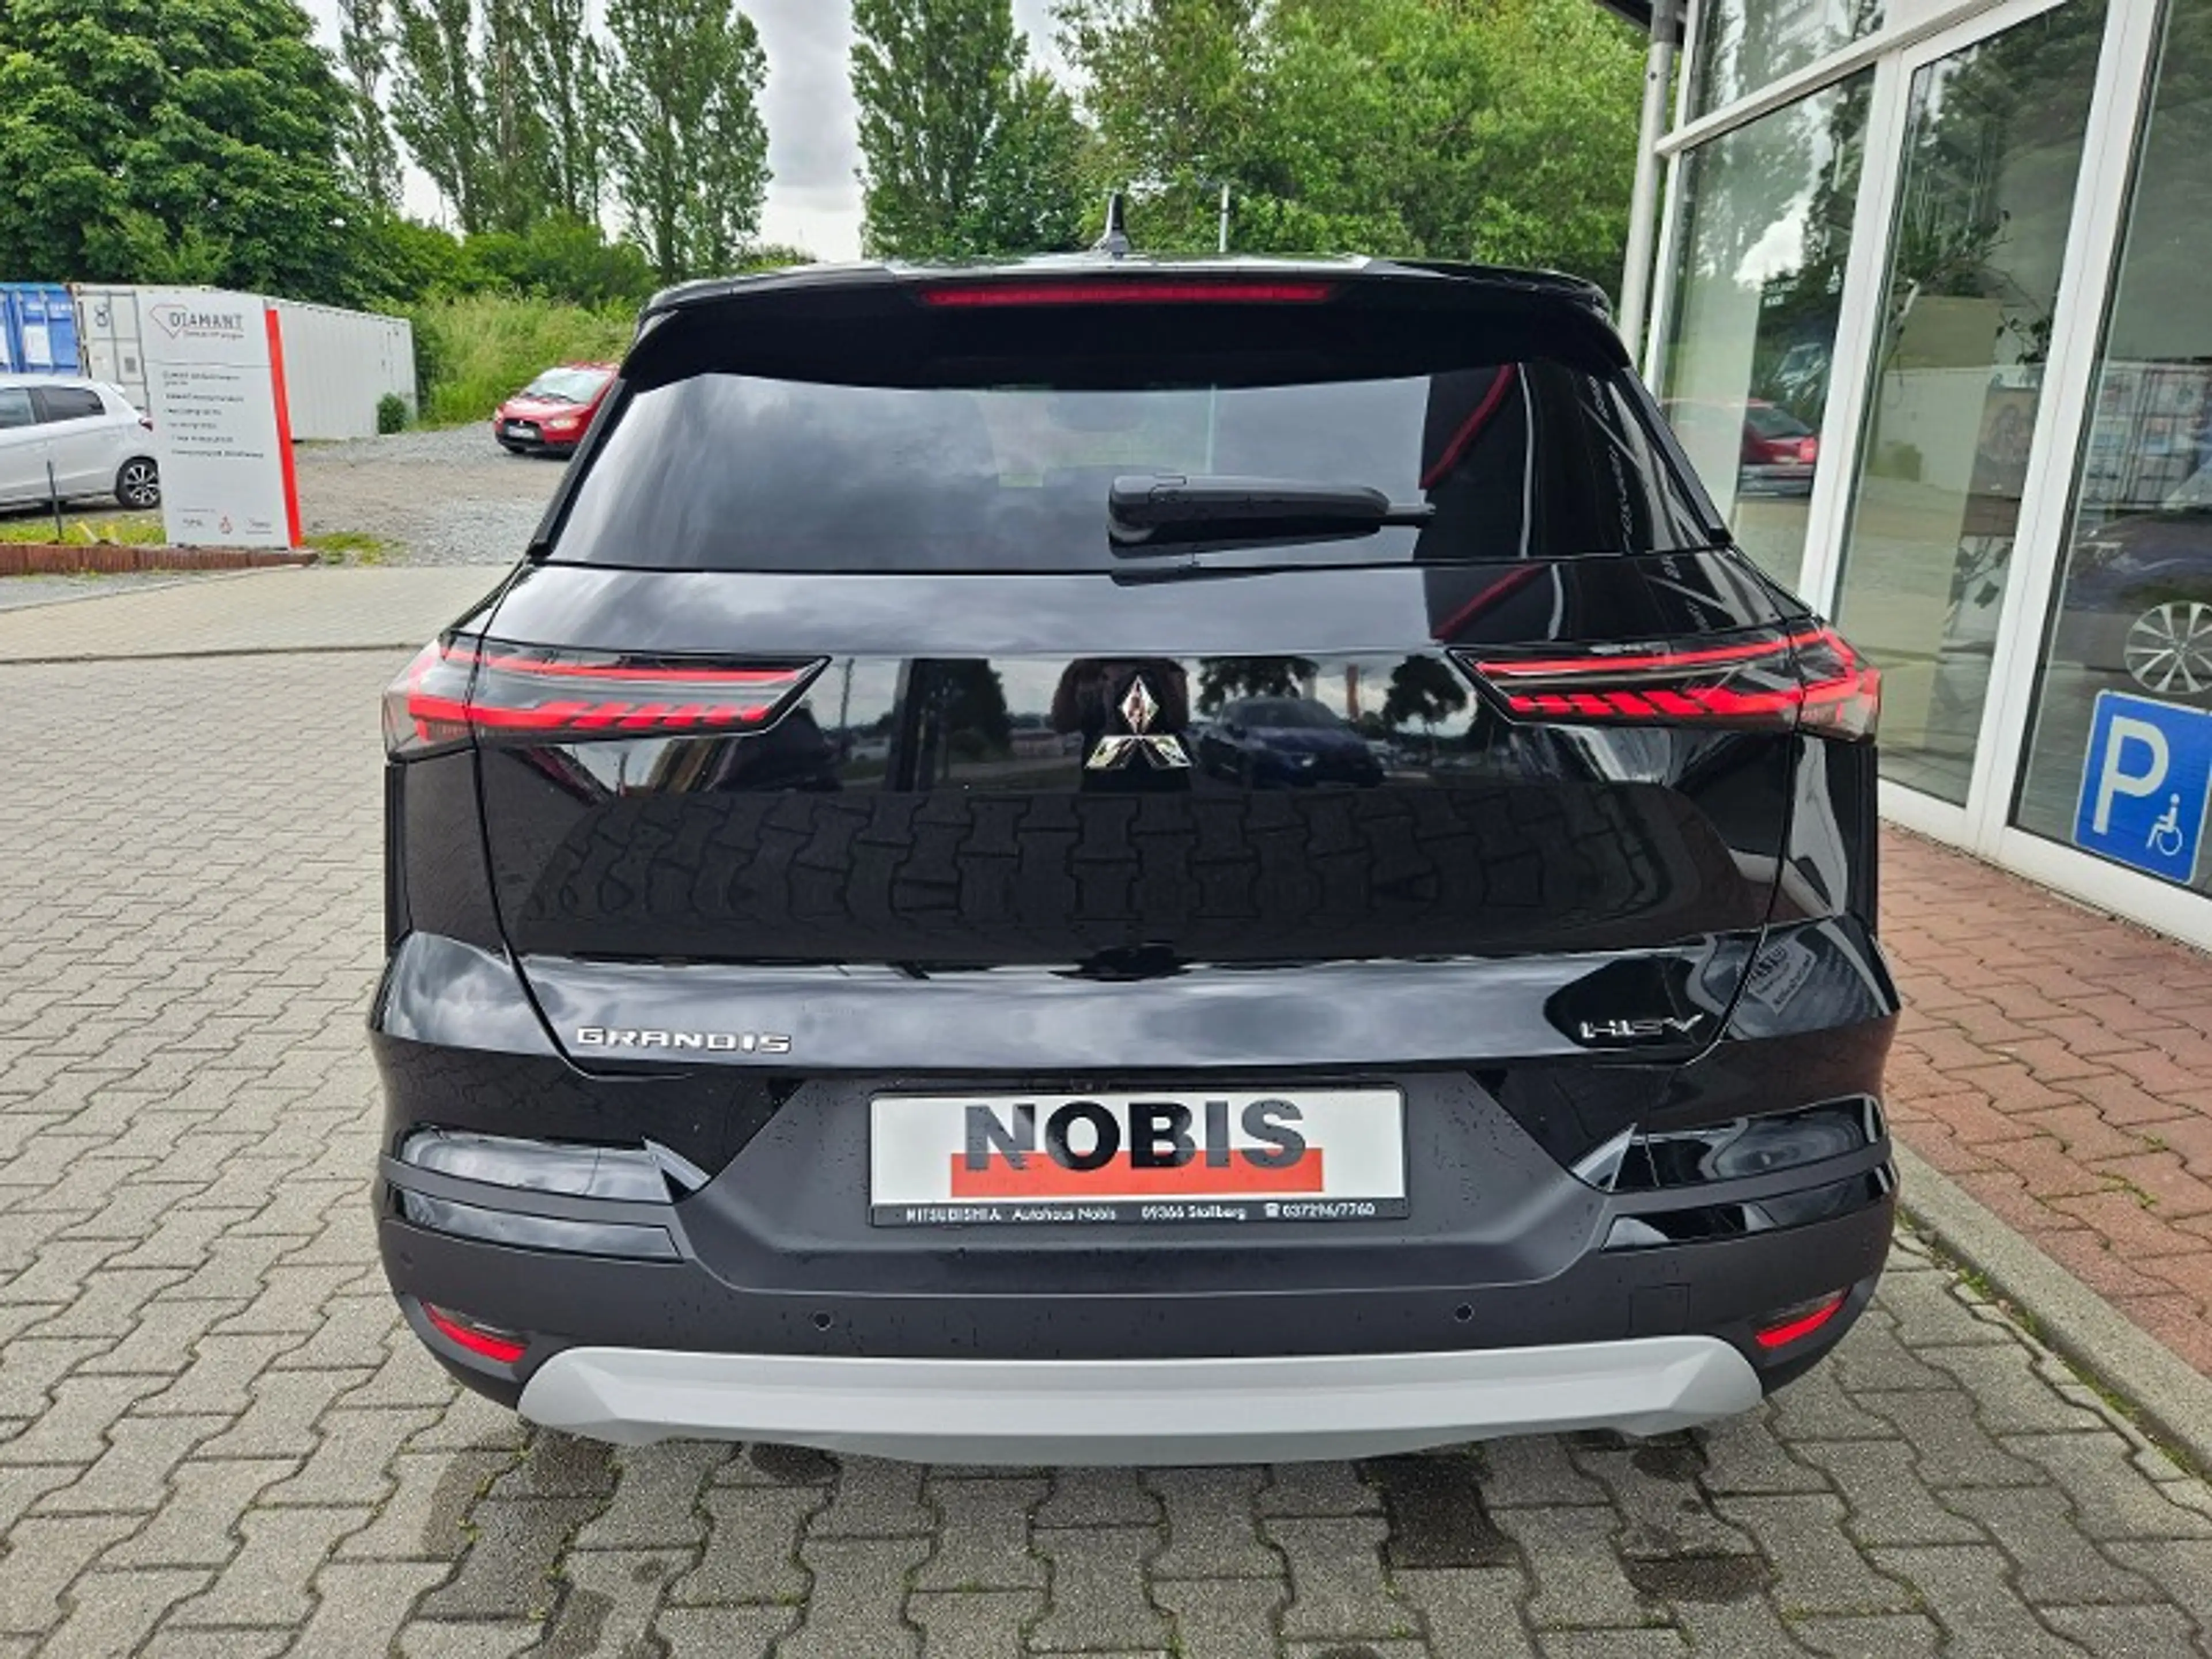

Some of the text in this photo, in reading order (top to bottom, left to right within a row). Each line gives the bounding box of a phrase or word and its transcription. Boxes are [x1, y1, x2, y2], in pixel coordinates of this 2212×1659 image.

[169, 312, 244, 329] DIAMANT
[2093, 715, 2169, 835] P
[577, 1028, 791, 1053] GRANDIS
[965, 1100, 1306, 1172] NOBIS
[906, 1209, 987, 1222] MITSUBISHI
[1012, 1207, 1074, 1221] Autohaus
[1078, 1207, 1116, 1220] Nobis
[1141, 1205, 1184, 1219] 09366
[1188, 1204, 1247, 1220] Stollberg
